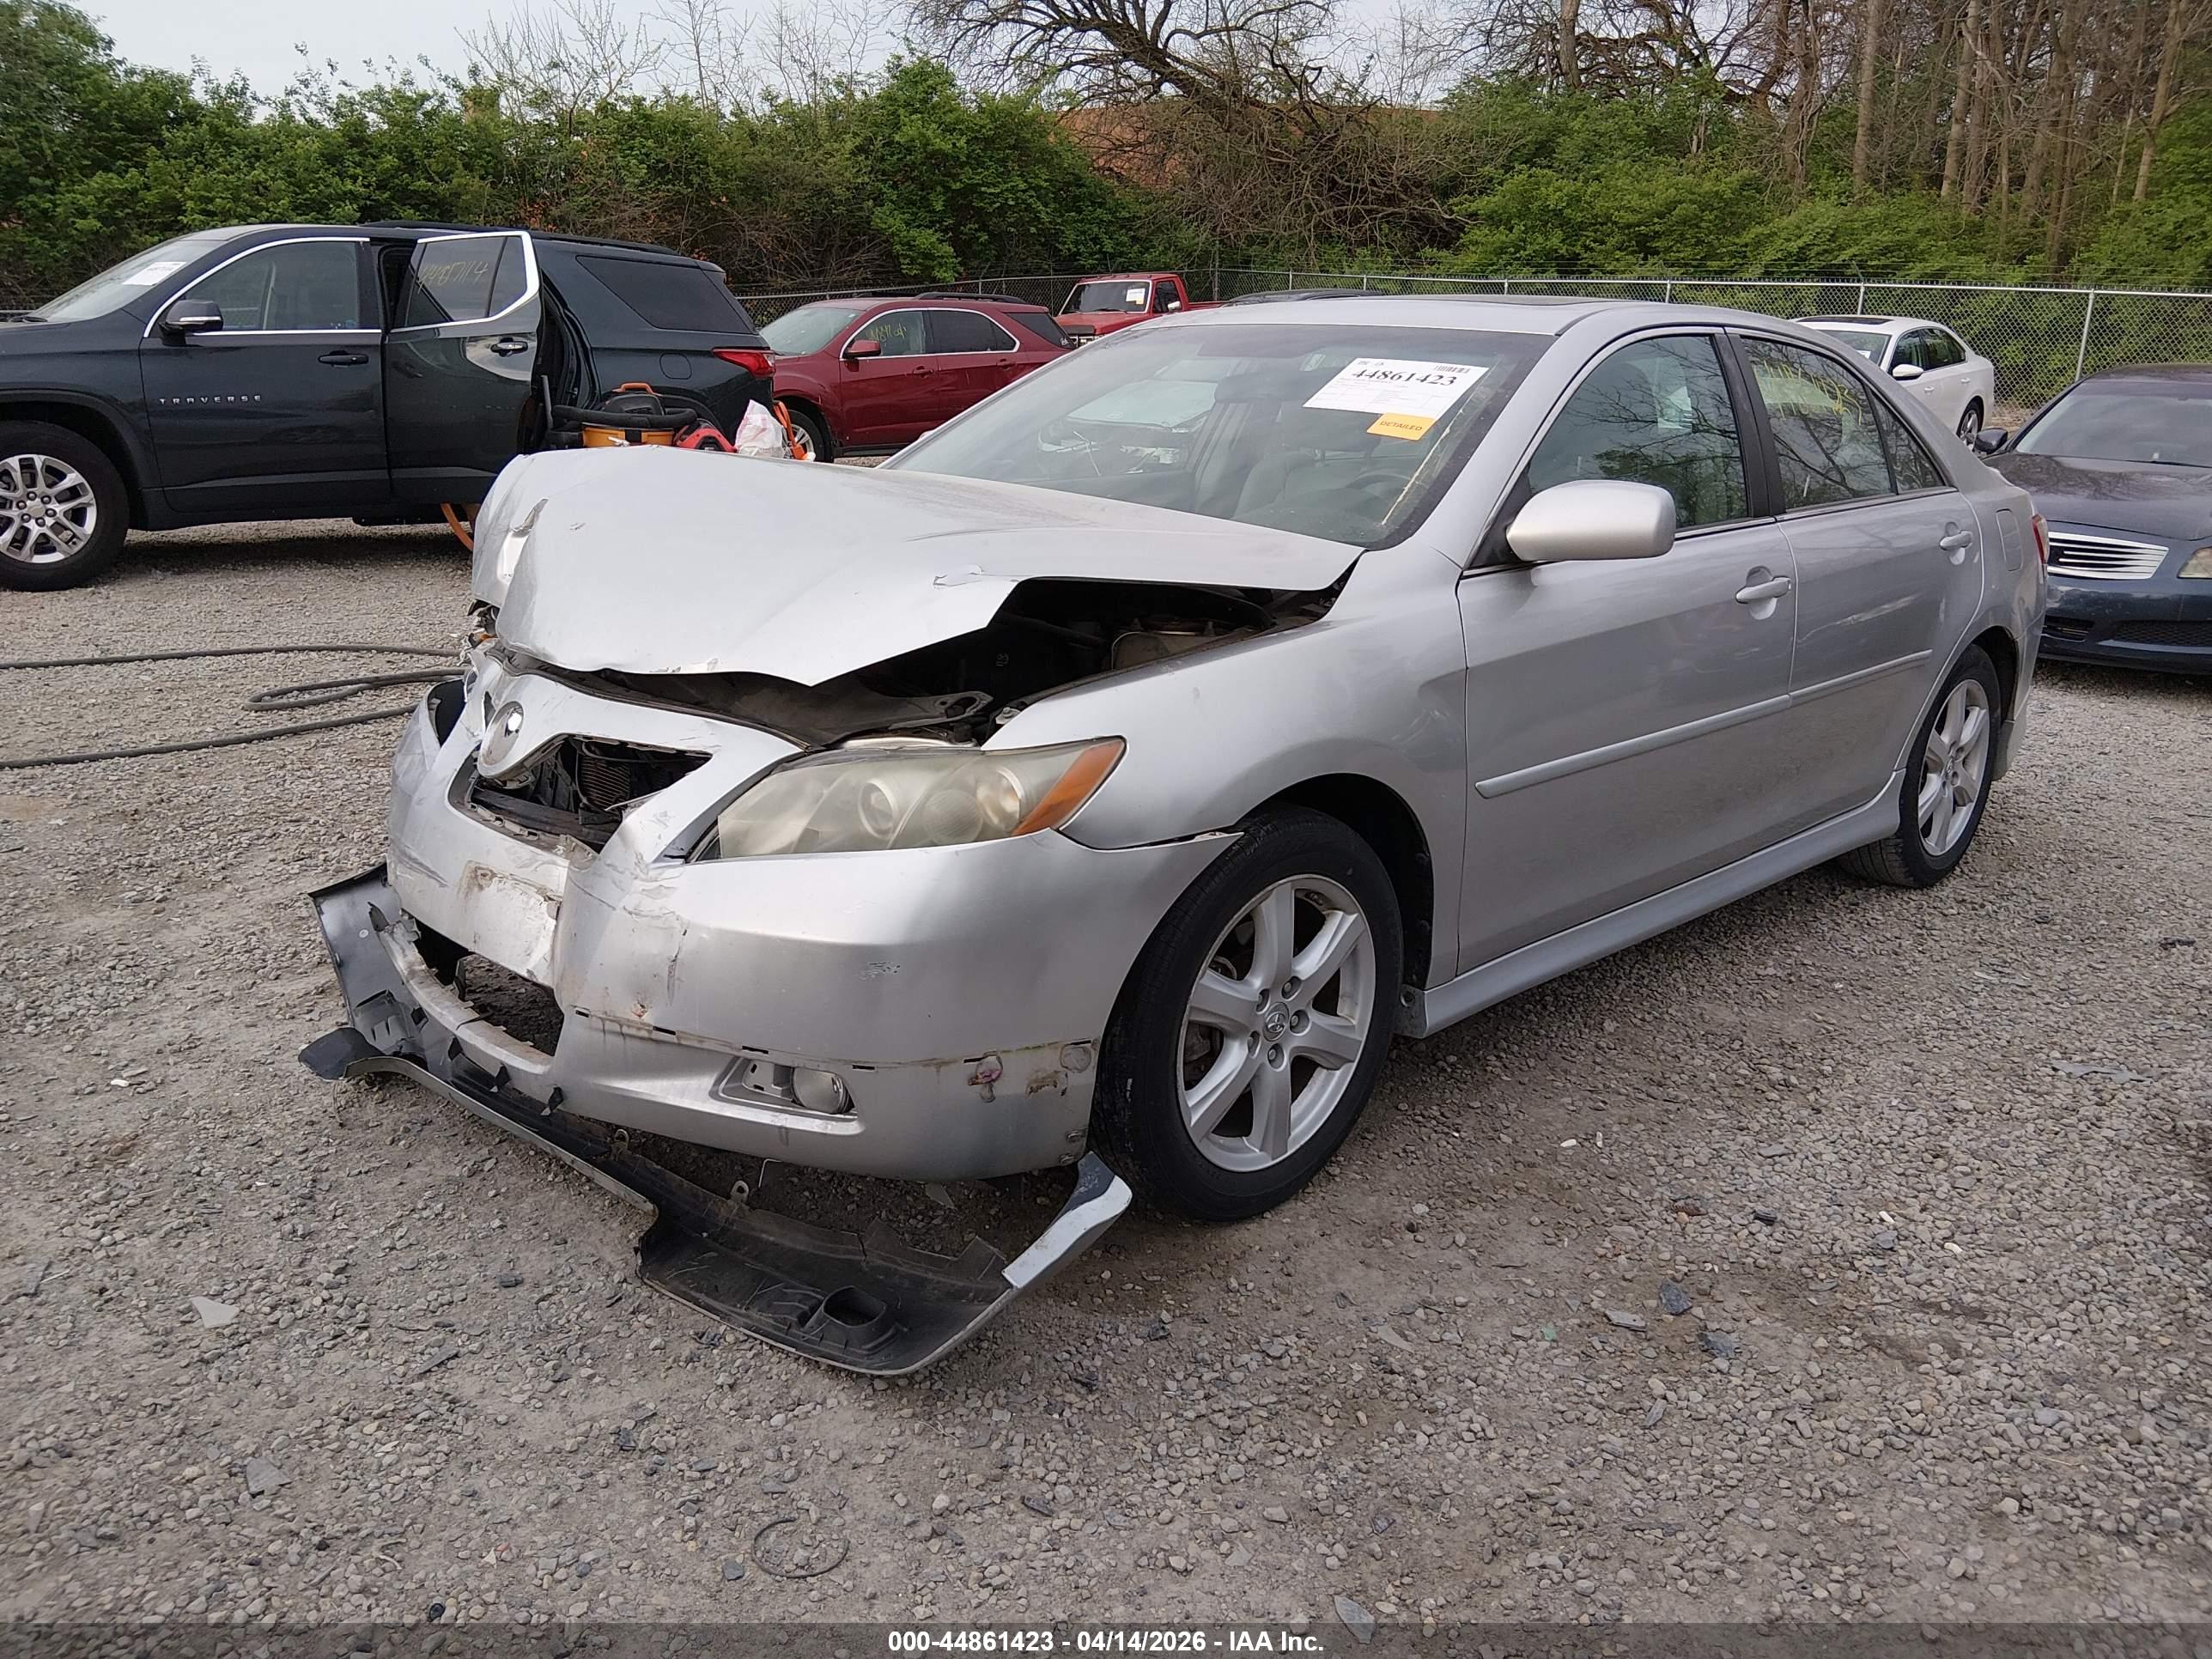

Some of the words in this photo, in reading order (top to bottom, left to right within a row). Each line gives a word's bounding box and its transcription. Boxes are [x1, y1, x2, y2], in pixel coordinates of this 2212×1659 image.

[1352, 368, 1457, 386] 44861423
[159, 395, 261, 405] TRAVERSE
[1379, 420, 1423, 431] DETAILED
